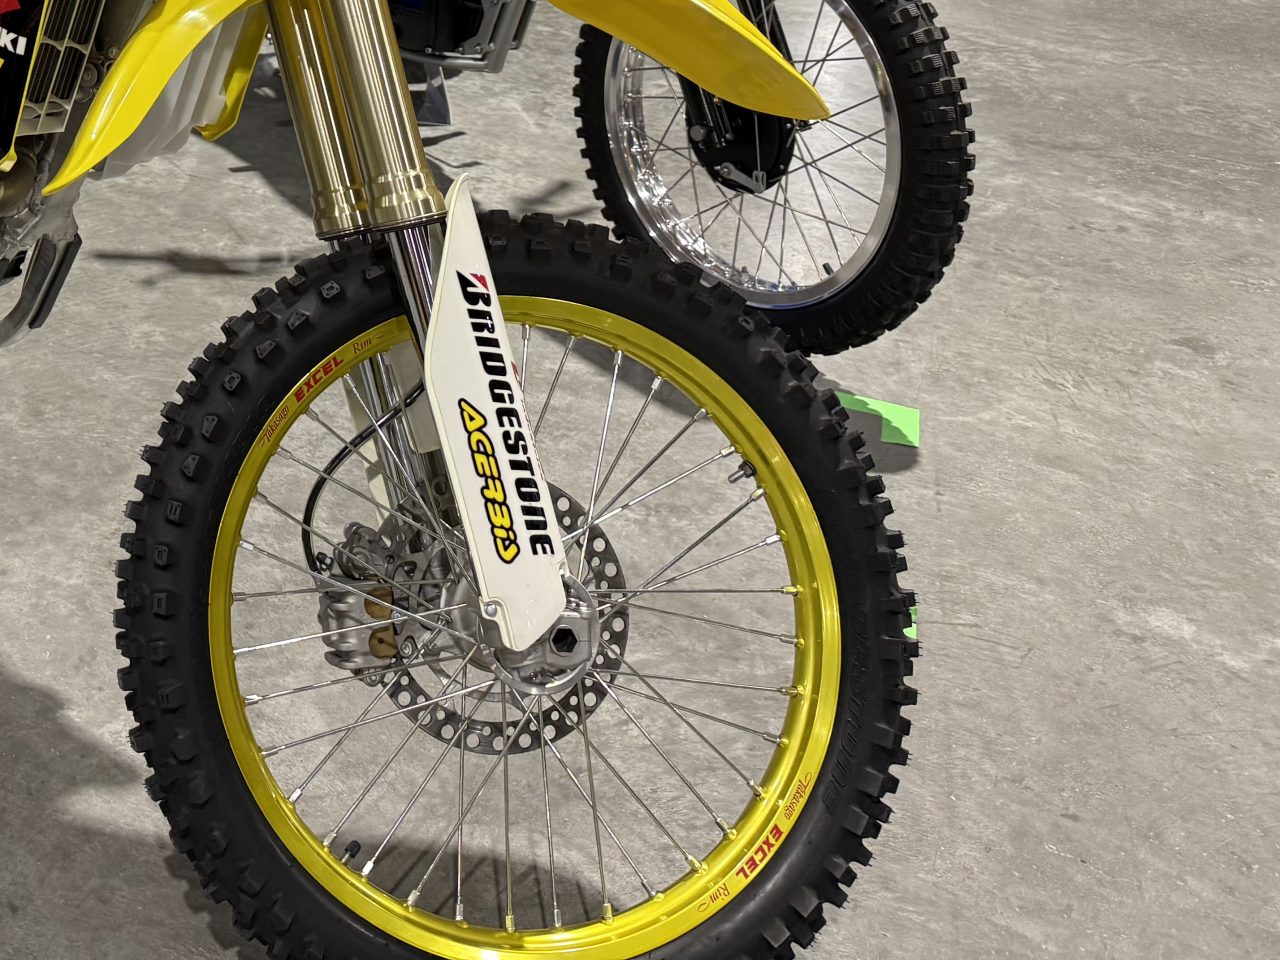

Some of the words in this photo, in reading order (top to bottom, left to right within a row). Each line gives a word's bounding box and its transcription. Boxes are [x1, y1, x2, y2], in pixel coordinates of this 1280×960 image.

[293, 355, 345, 404] EXCEL
[456, 269, 555, 557] BRIDGESTONE
[734, 823, 784, 881] EXCEL
[705, 881, 731, 905] Rim
